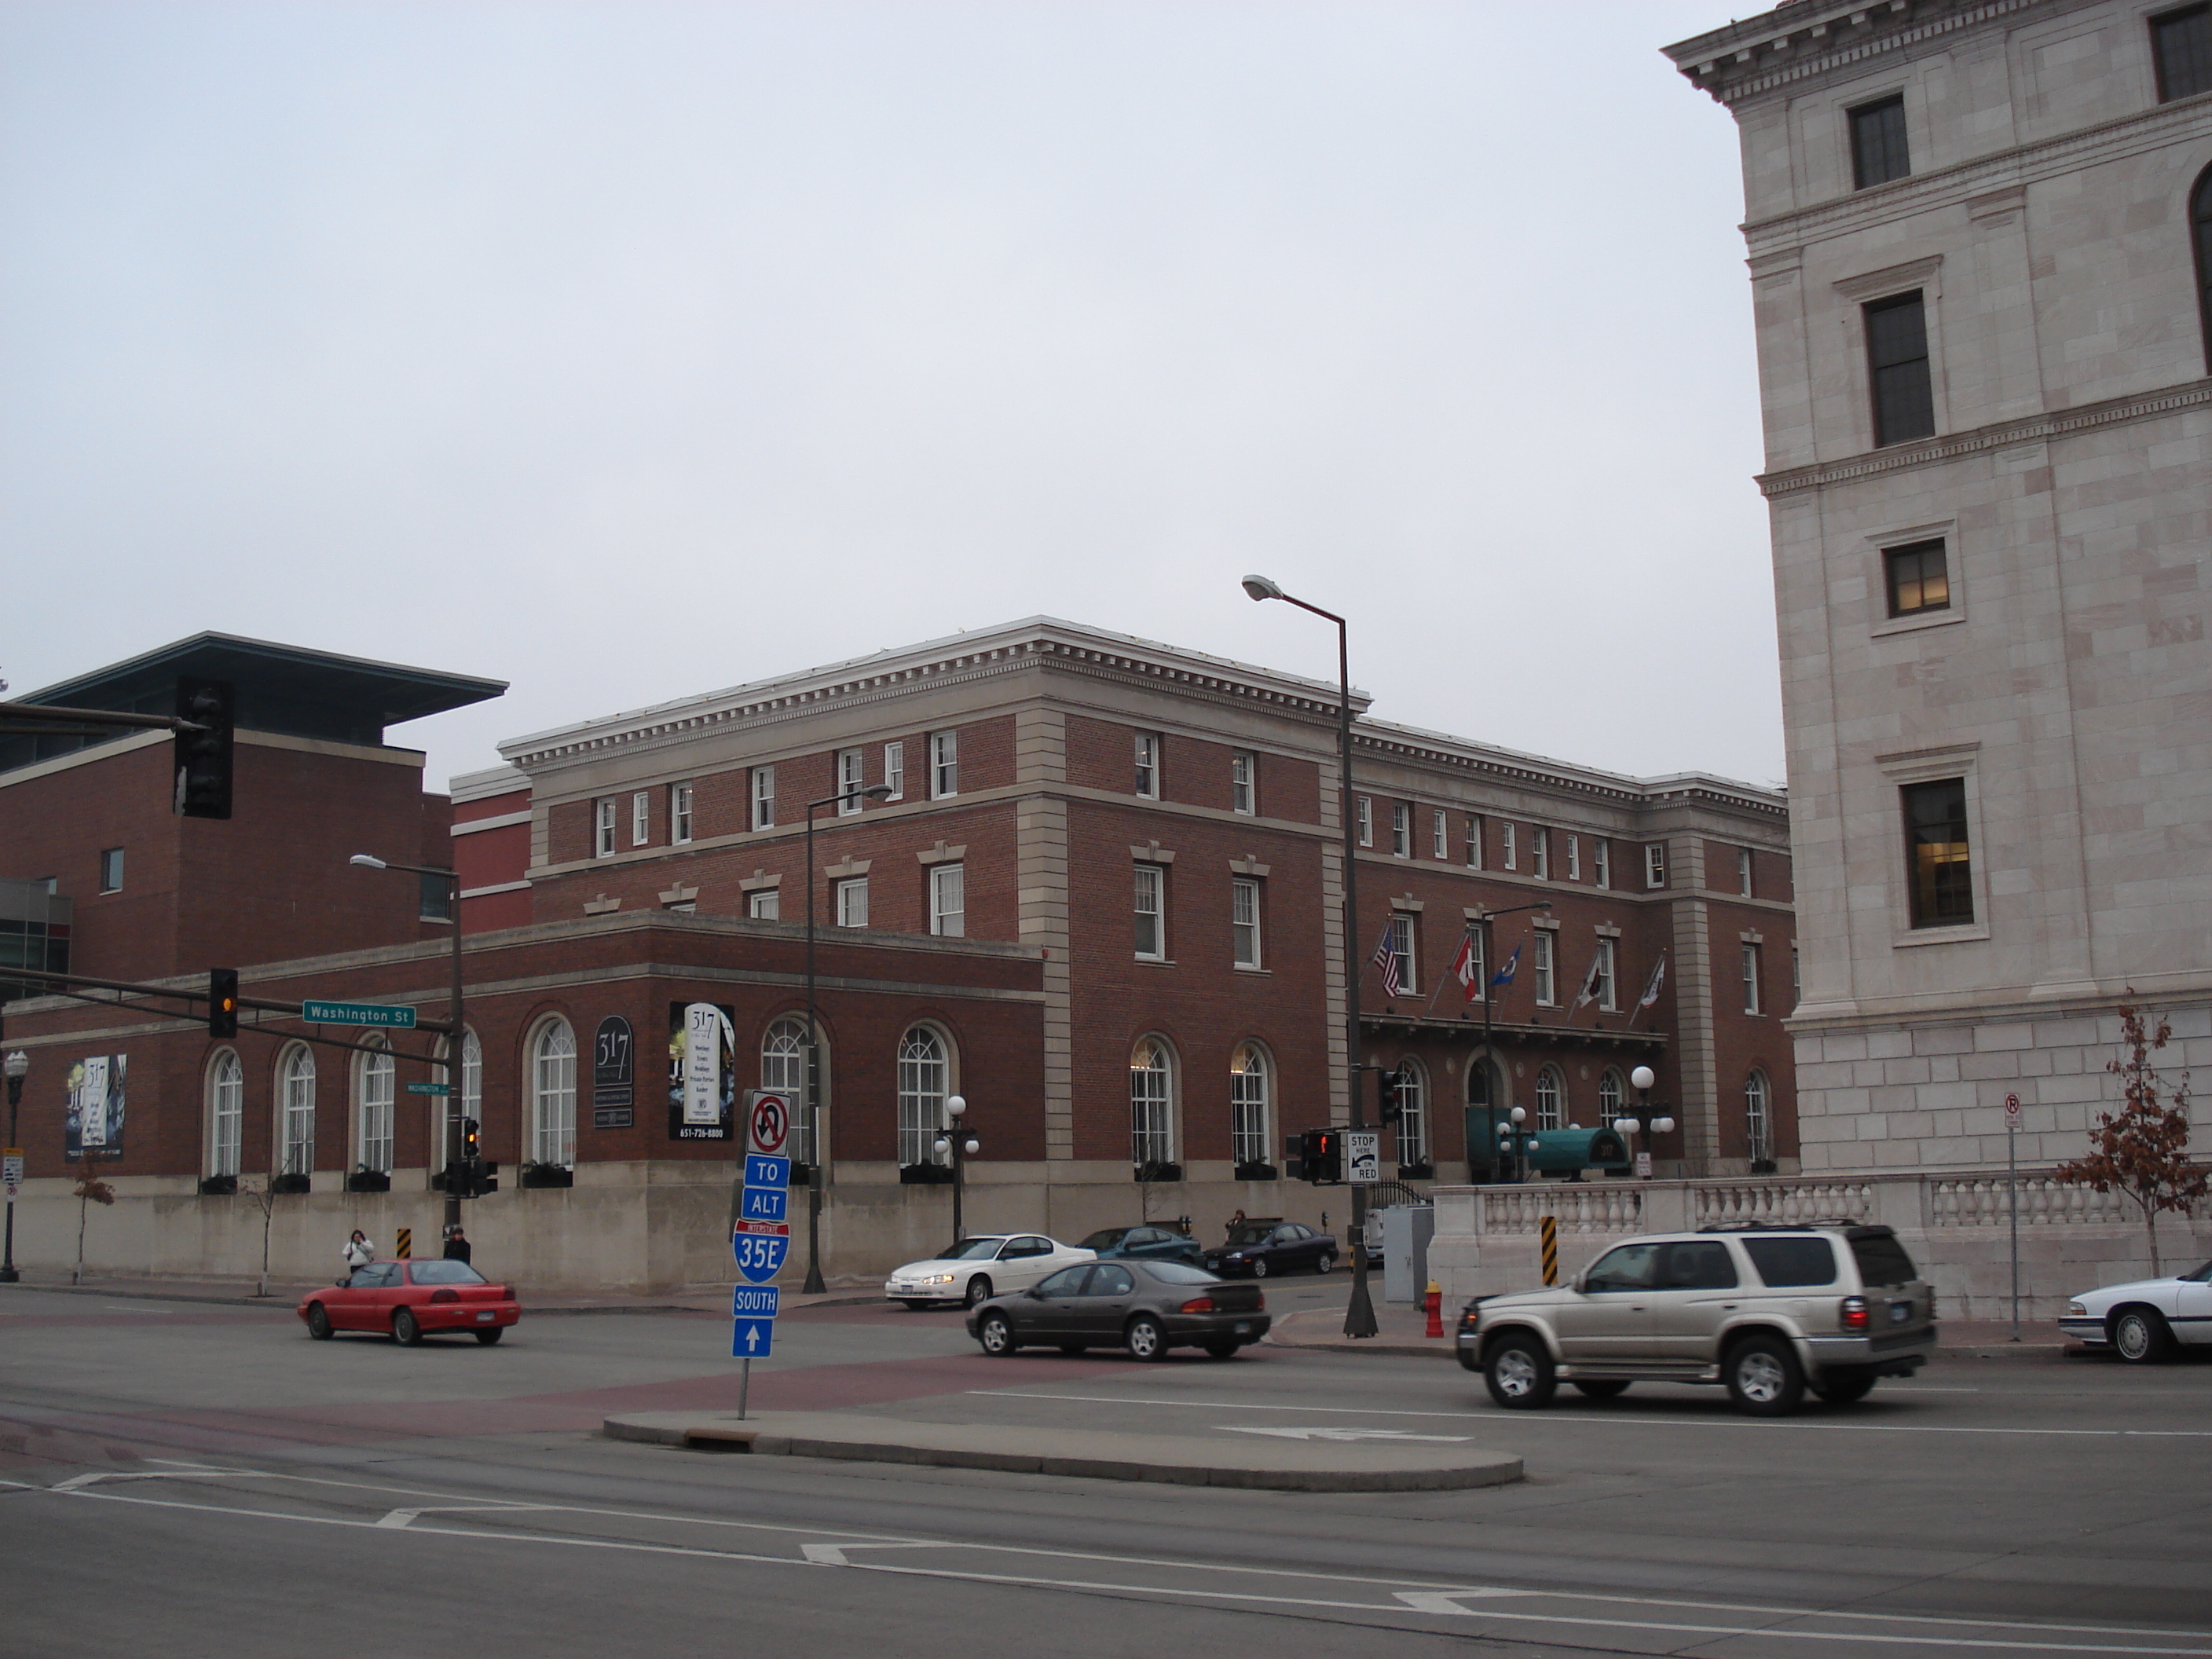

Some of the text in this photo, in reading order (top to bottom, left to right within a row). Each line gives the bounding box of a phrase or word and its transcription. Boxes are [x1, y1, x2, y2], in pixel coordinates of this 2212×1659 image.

[311, 1006, 408, 1024] Washington St
[692, 1011, 715, 1039] 317
[598, 1030, 629, 1080] 317
[88, 1063, 105, 1088] 317
[1351, 1136, 1375, 1146] STOP
[756, 1163, 778, 1181] TO
[1359, 1169, 1376, 1179] RED
[751, 1195, 780, 1214] ALT
[747, 1224, 778, 1235] INTERSTATE
[739, 1238, 780, 1269] 35E
[736, 1291, 776, 1311] SOUTH
